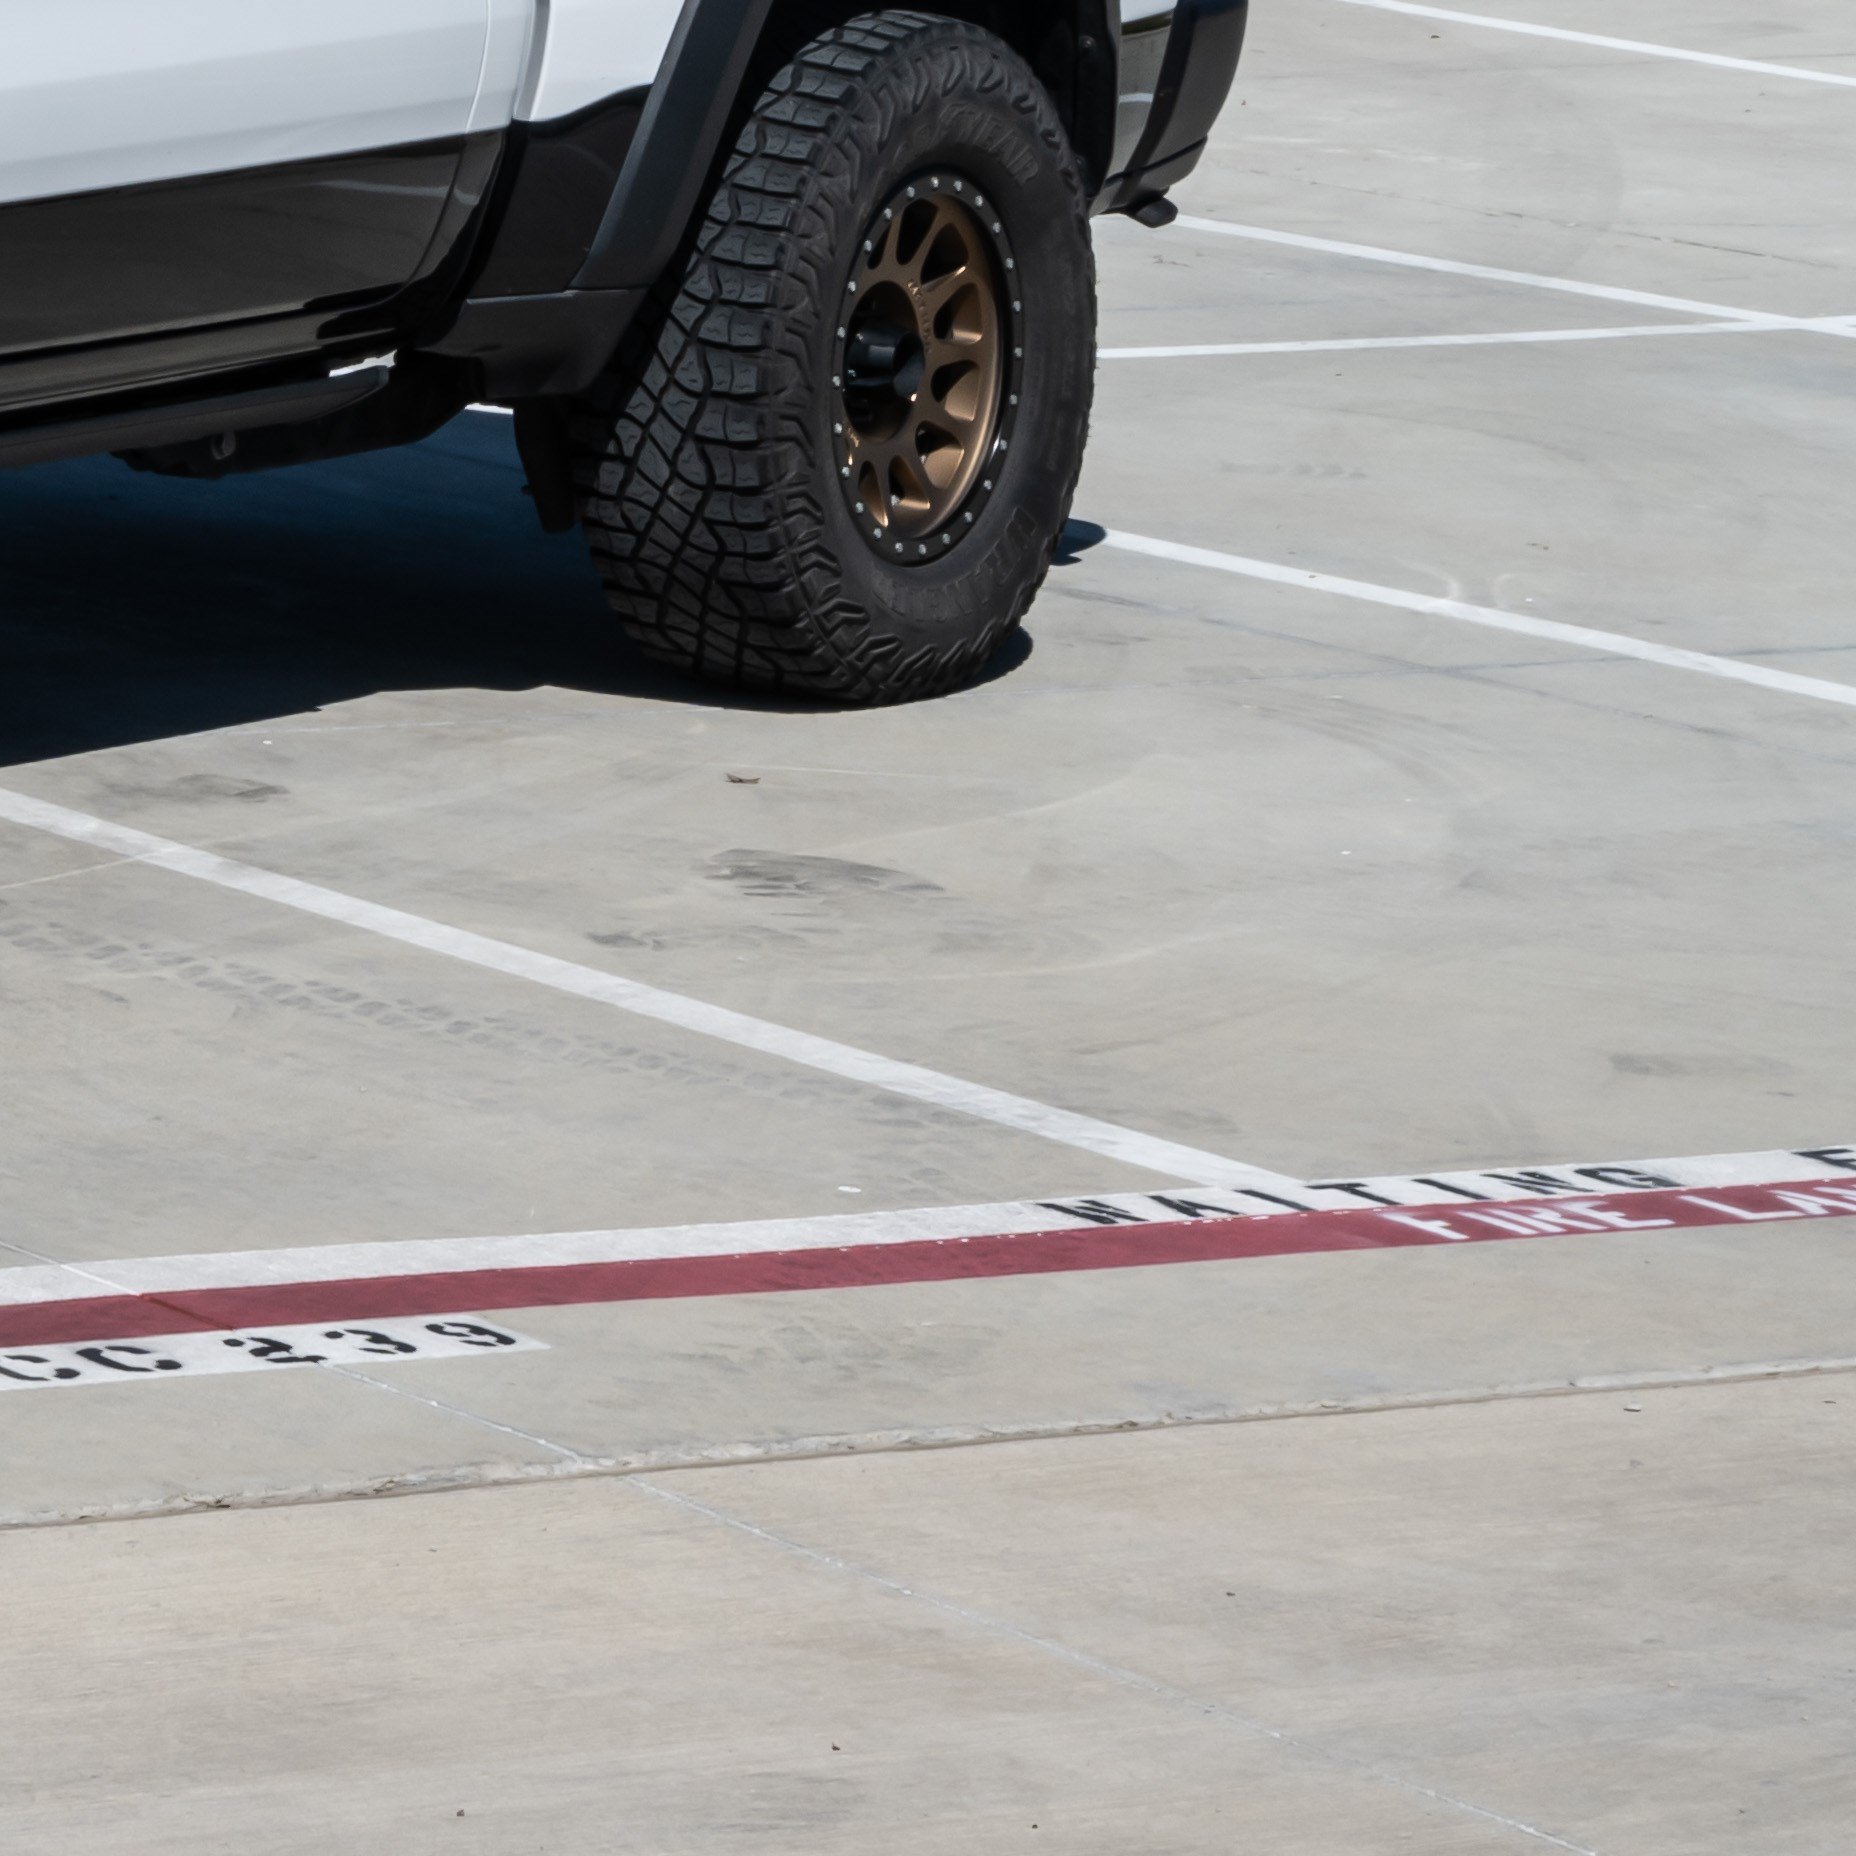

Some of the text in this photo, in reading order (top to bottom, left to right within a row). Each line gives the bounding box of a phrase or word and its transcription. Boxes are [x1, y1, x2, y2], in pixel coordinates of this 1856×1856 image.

[1034, 1166, 1686, 1225] WAITING
[1376, 1199, 1676, 1241] FIRE
[221, 1321, 517, 1364] 239
